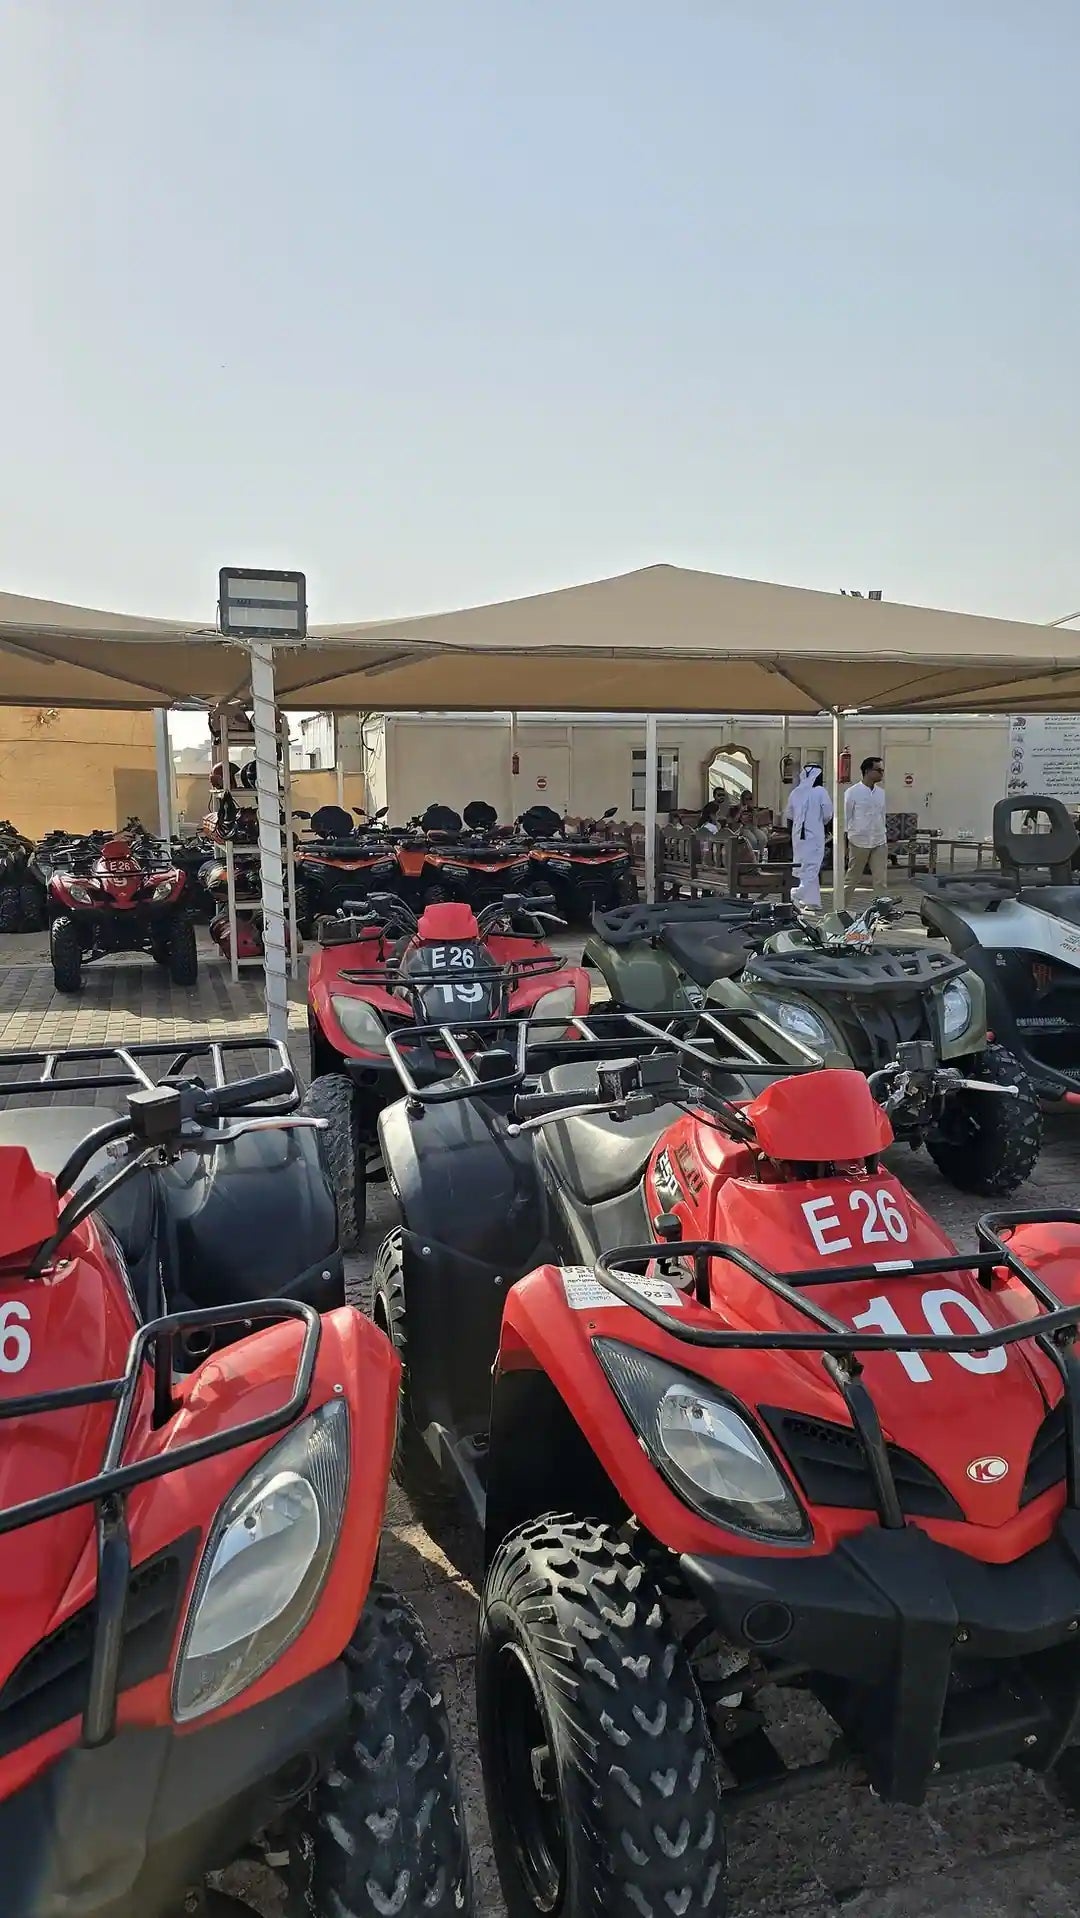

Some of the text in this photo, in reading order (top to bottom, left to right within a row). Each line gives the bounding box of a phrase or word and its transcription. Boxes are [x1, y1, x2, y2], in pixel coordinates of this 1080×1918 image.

[110, 861, 131, 871] E 26
[432, 946, 475, 969] E 26
[800, 1189, 909, 1256] E 26
[0, 1301, 32, 1373] 6
[851, 1288, 1008, 1383] 10
